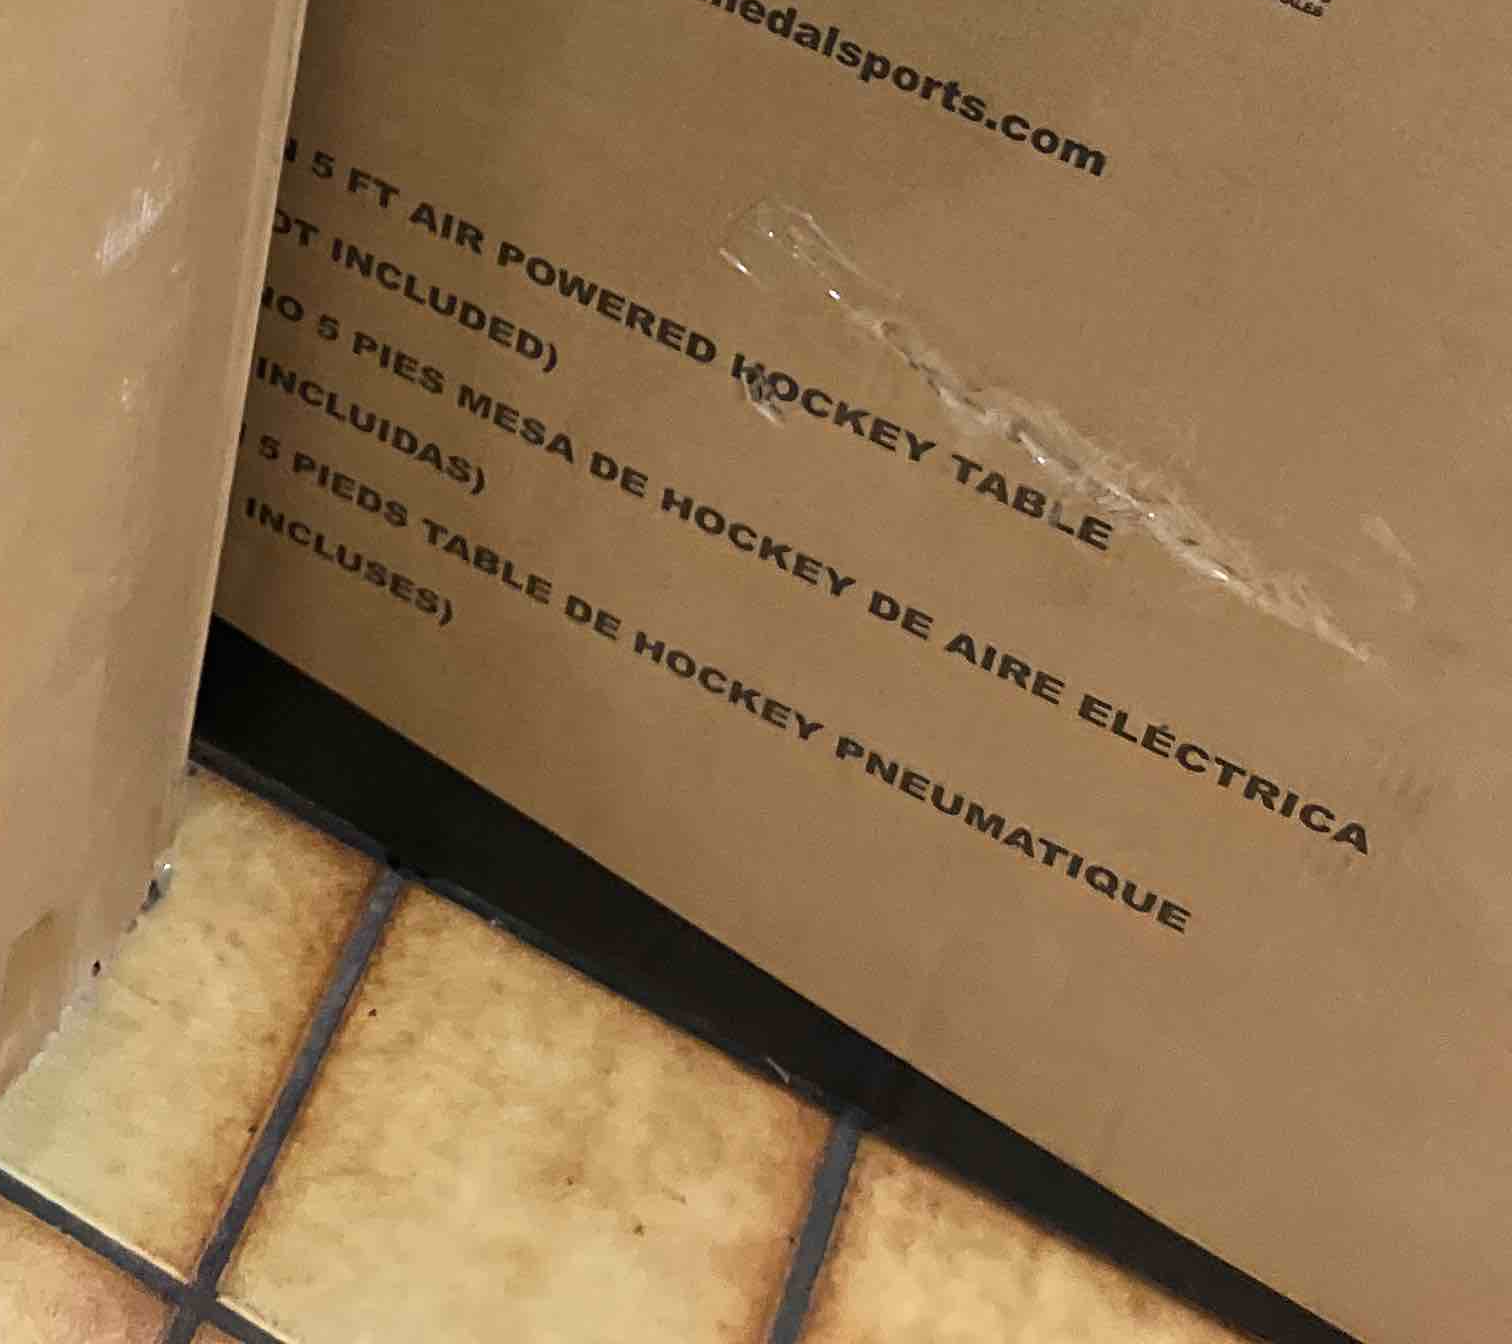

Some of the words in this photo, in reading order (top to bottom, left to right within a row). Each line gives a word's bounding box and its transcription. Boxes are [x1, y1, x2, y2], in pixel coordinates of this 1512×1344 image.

[253, 353, 487, 497] INCLUIDAS)
[311, 149, 336, 180] 5
[347, 166, 401, 209] FT
[409, 200, 485, 256] AIR
[495, 240, 718, 366] POWERED
[730, 352, 937, 464] HOCKEY
[950, 453, 1115, 554] TABLE
[331, 237, 560, 375] INCLUDED)
[244, 495, 456, 628] INCLUSES)
[258, 435, 281, 464] 5
[292, 452, 410, 530] PIEDS
[422, 517, 553, 606] TABLE
[564, 594, 621, 642] DE
[632, 631, 825, 743] HOCKEY
[834, 735, 1192, 934] PNEUMATIQUE
[317, 313, 340, 343] 5
[352, 330, 446, 397] PIES
[456, 382, 576, 465] MESA
[589, 450, 650, 499] DE
[660, 487, 857, 599] HOCKEY
[866, 590, 936, 641] DE
[944, 630, 1067, 708] AIRE
[1076, 692, 1372, 856] ELÉCTRICA
